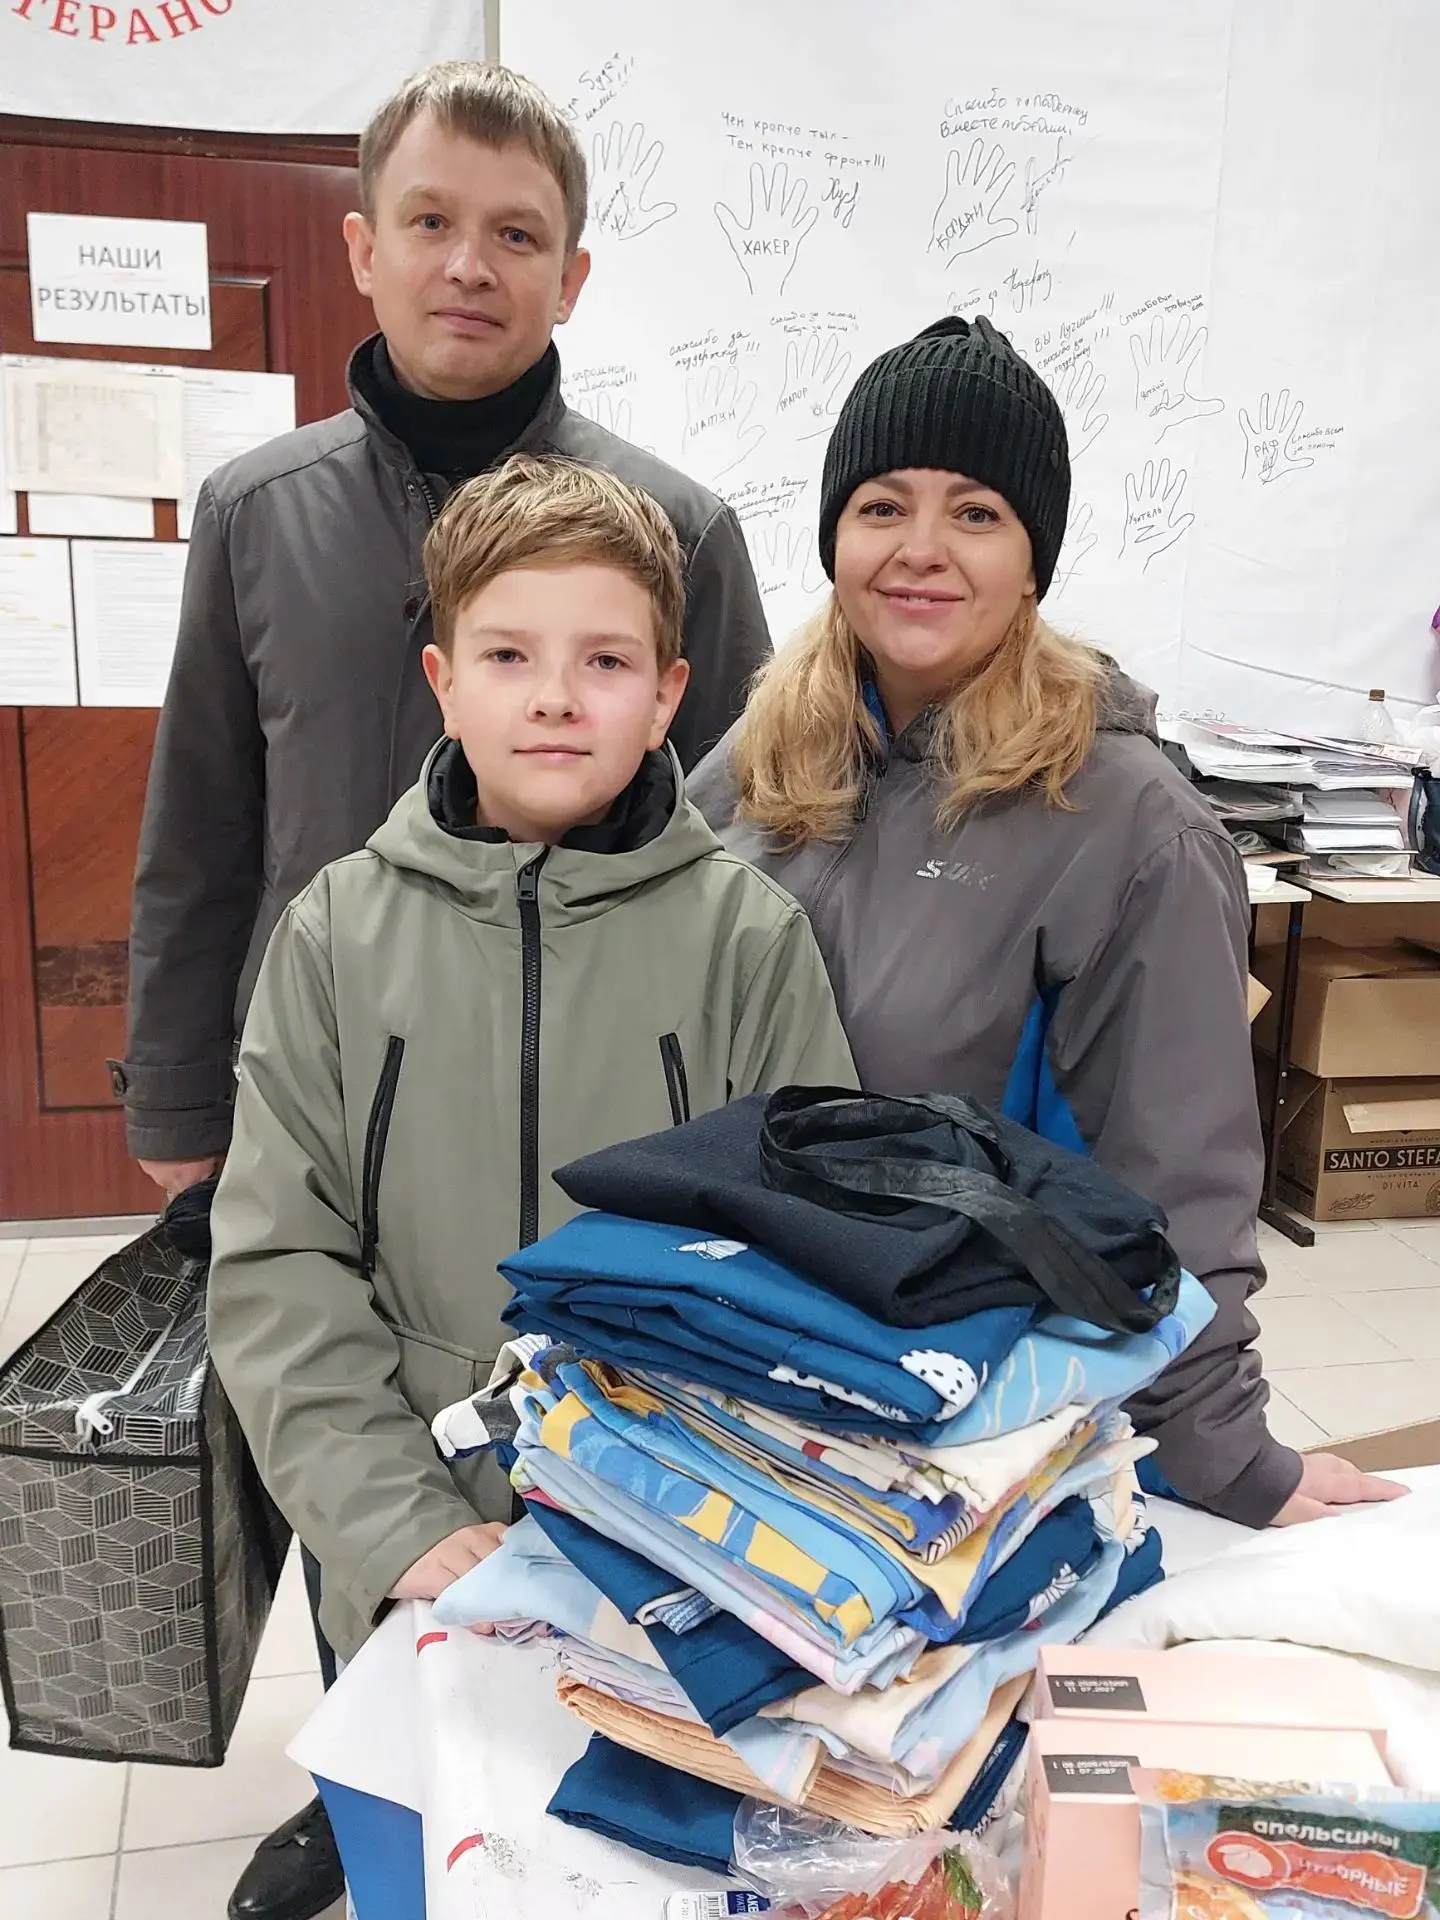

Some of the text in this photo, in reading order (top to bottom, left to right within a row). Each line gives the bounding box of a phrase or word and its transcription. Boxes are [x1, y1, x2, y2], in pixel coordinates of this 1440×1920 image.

[79, 245, 162, 270] НАШИ
[742, 238, 790, 256] ХАКЕР
[37, 287, 206, 317] РЕЗУЛЬТАТЫ
[1330, 1150, 1390, 1169] SANTO
